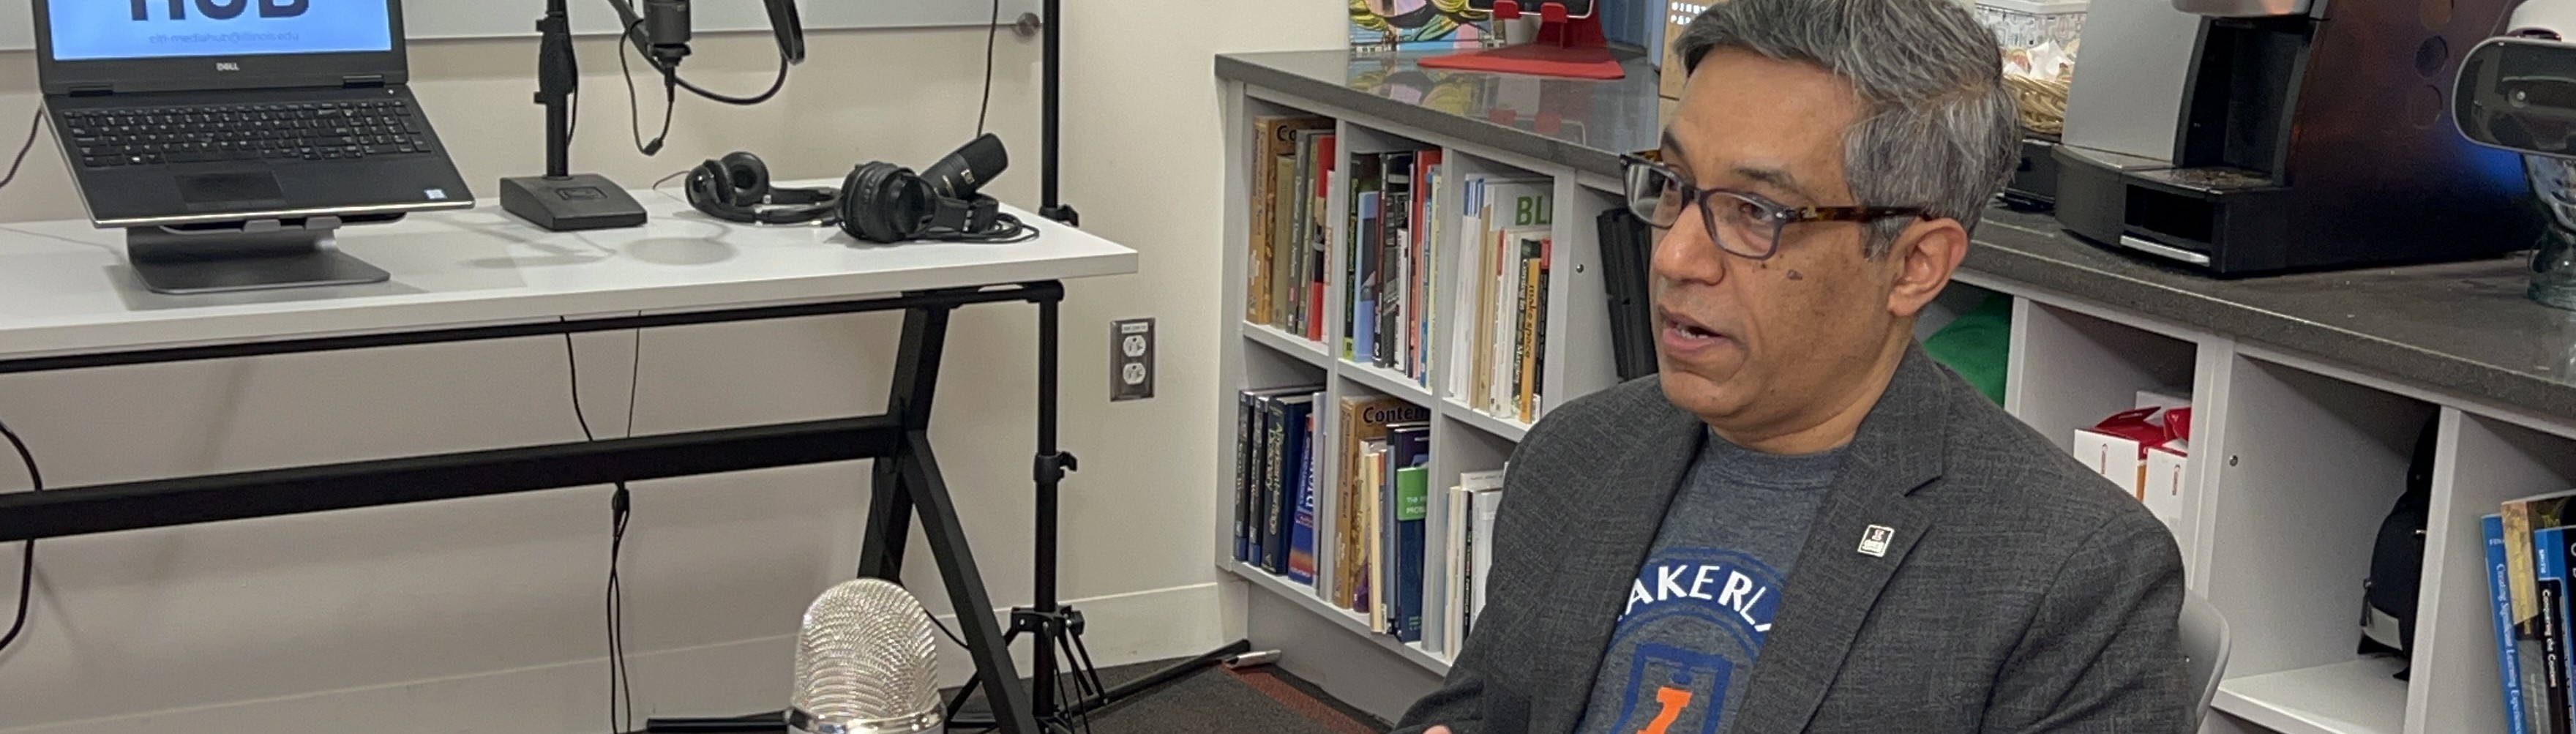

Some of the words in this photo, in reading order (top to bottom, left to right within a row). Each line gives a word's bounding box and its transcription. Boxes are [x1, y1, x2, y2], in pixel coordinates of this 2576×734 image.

[216, 62, 239, 71] DELL
[1516, 195, 1548, 226] BL
[1528, 285, 1538, 320] make
[1524, 322, 1533, 359] space
[1617, 564, 1772, 633] AKERL
[2541, 589, 2553, 637] Conquering
[2496, 563, 2507, 602] Creating
[2506, 649, 2517, 687] Learning
[2546, 637, 2556, 652] the
